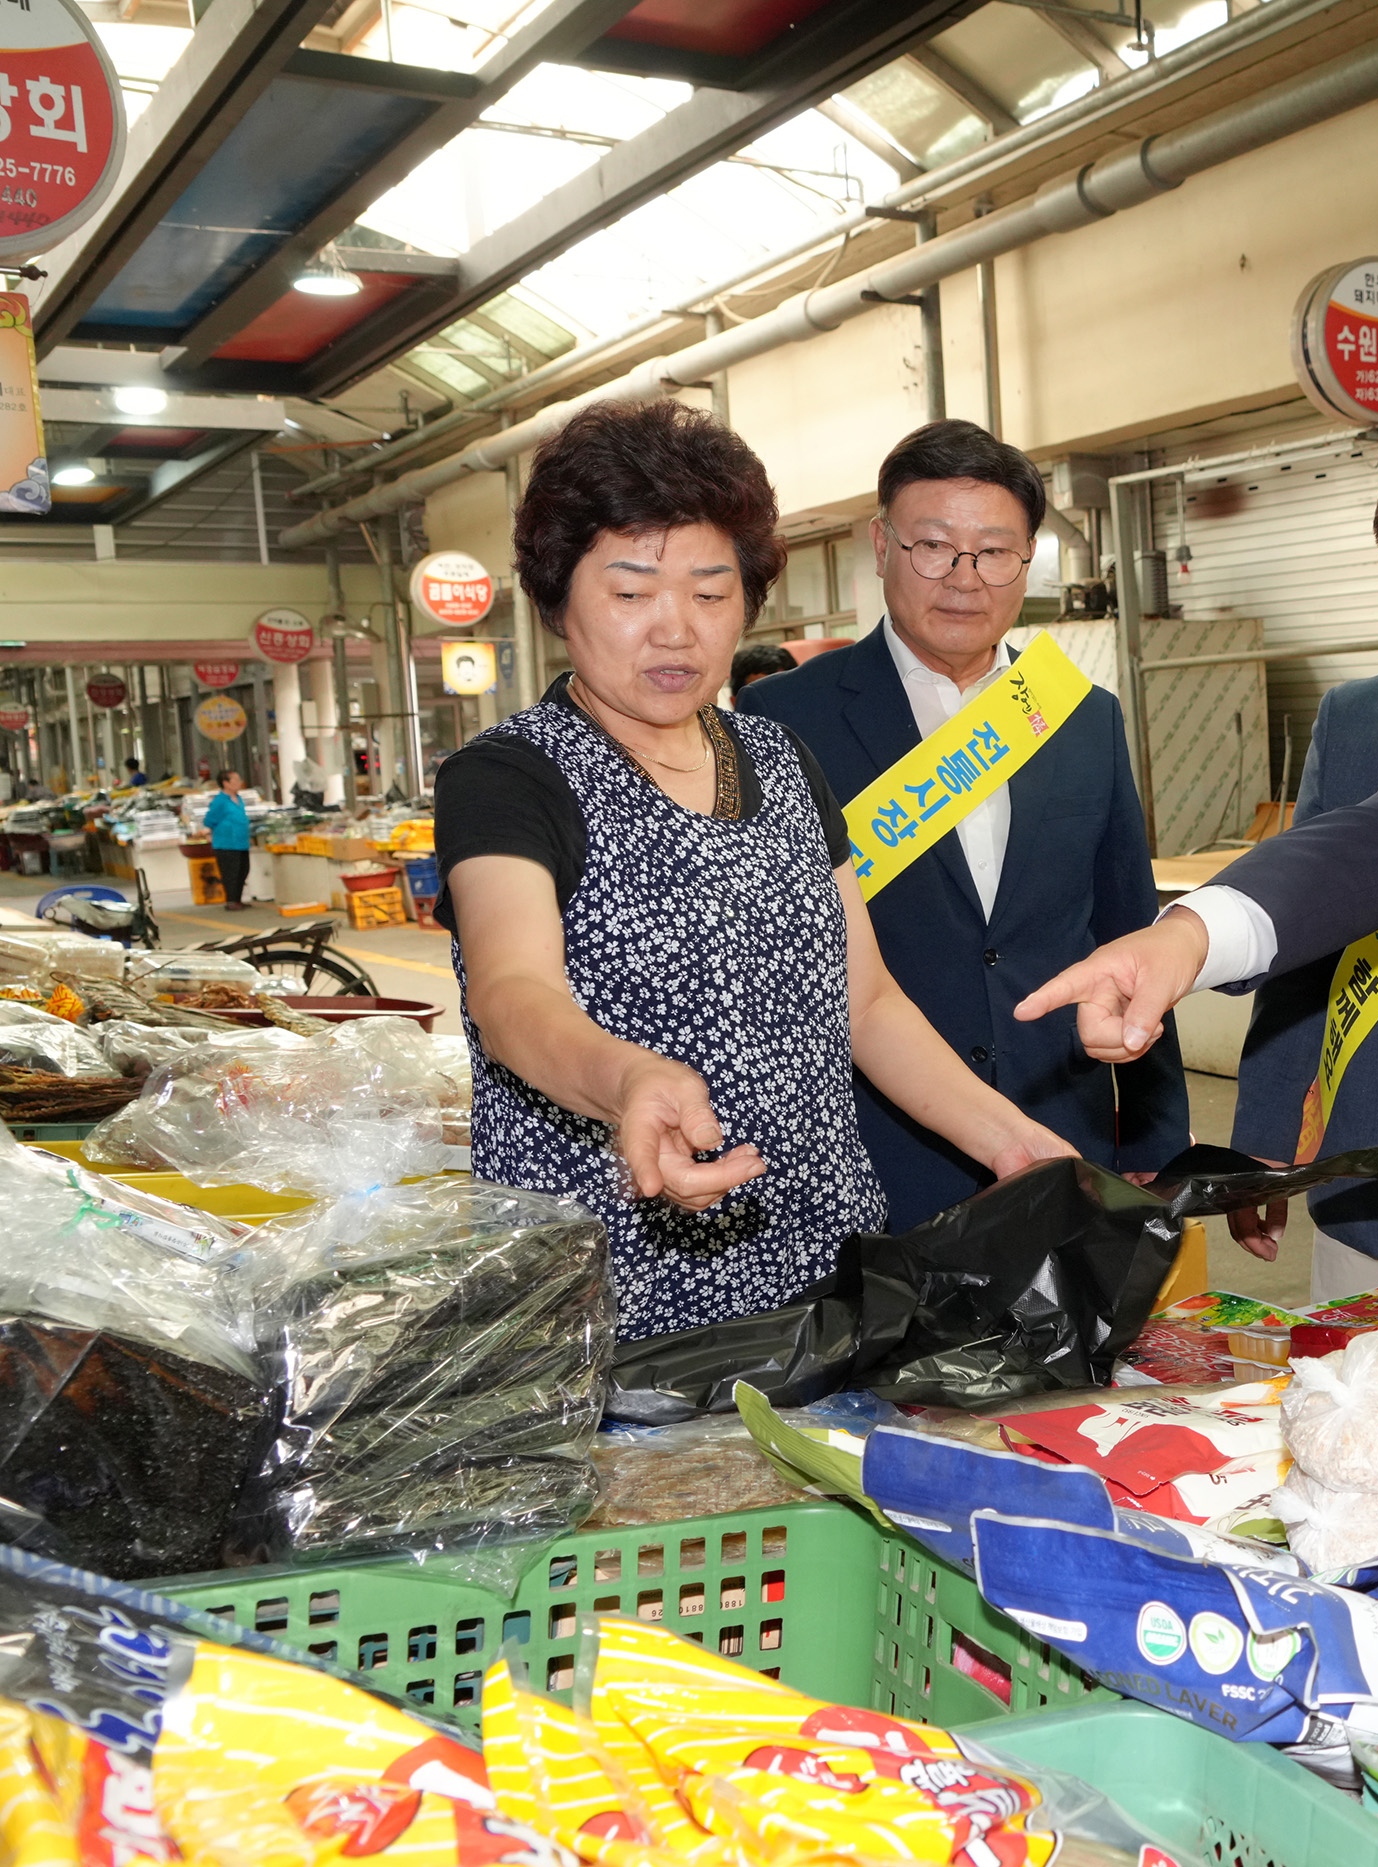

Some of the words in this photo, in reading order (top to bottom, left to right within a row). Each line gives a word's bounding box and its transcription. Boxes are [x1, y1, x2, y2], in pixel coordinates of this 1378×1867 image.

[871, 721, 1011, 848] 전통시장
[1164, 1681, 1238, 1732] LAVER
[1221, 1683, 1257, 1701] FSSC
